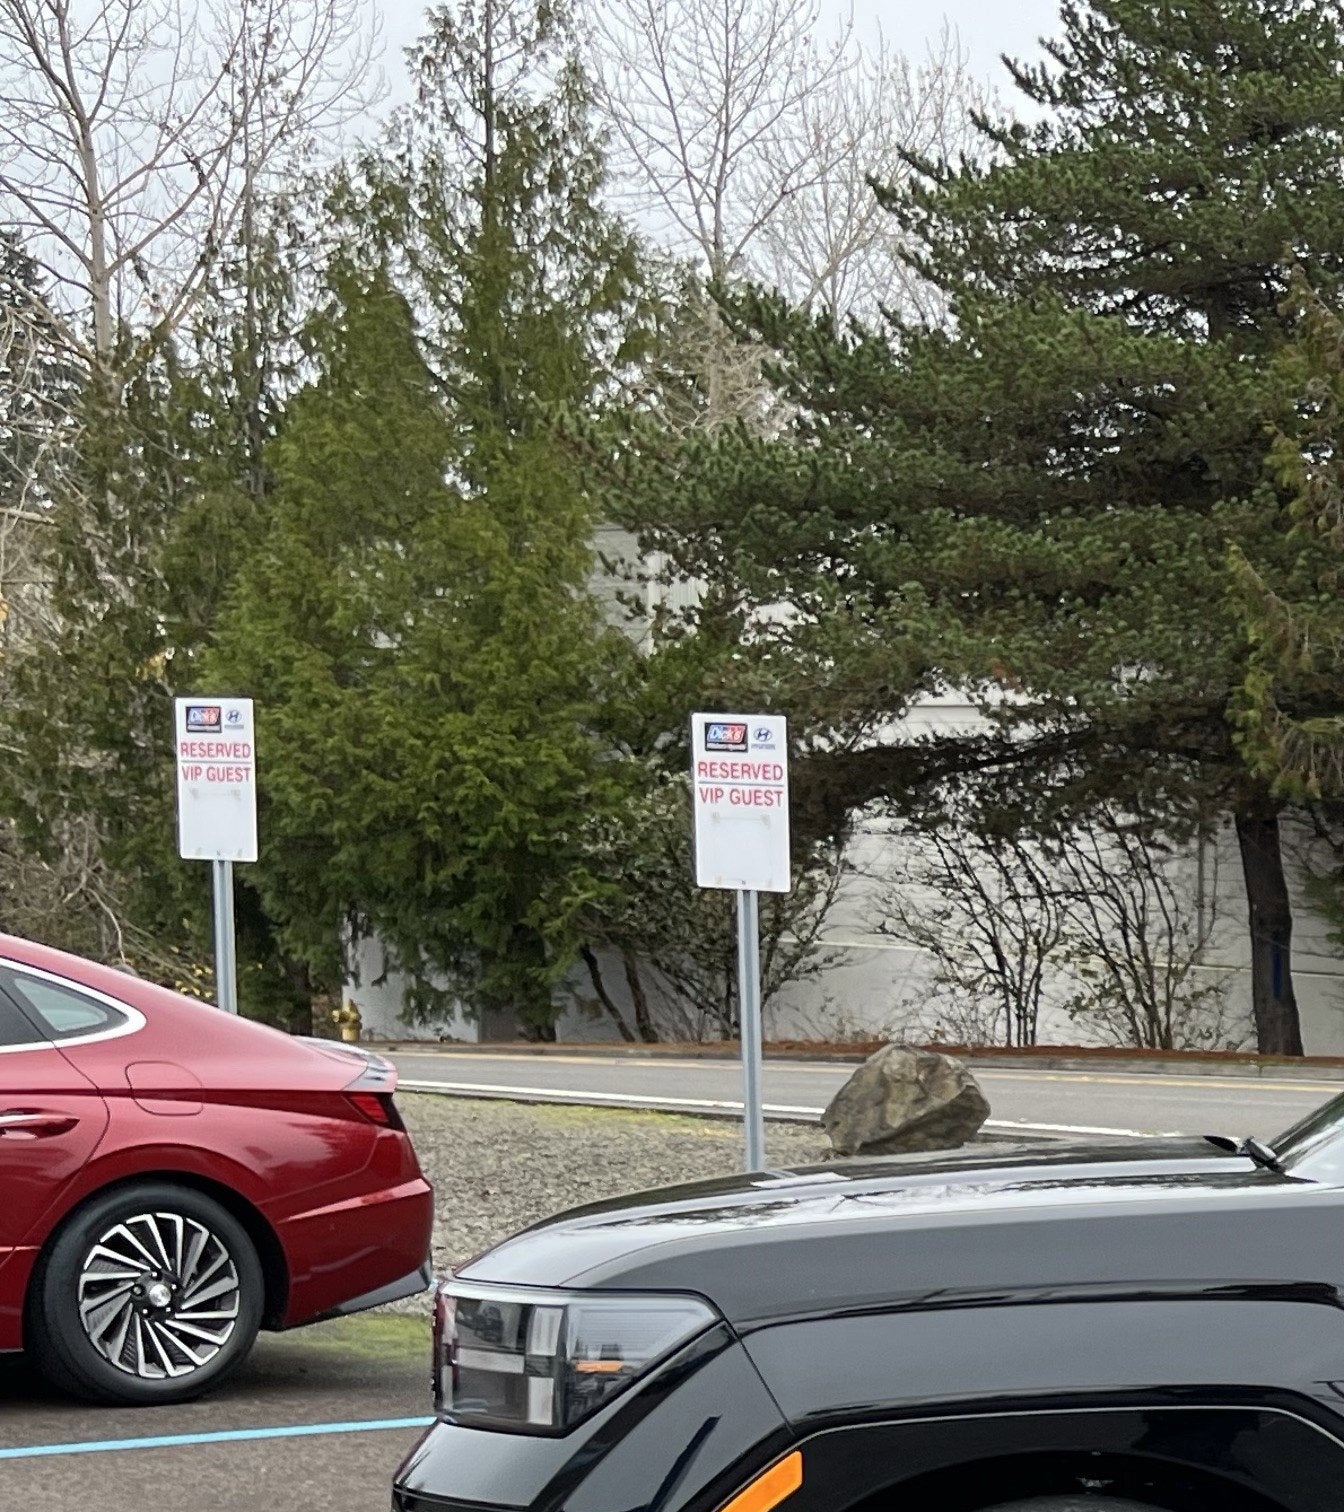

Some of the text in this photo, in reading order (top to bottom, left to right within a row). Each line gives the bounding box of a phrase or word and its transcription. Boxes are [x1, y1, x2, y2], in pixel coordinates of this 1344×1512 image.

[180, 741, 252, 759] RESERVED
[182, 765, 252, 783] VIP GUEST
[697, 760, 784, 781] RESERVED
[699, 786, 784, 807] VIP GUEST
